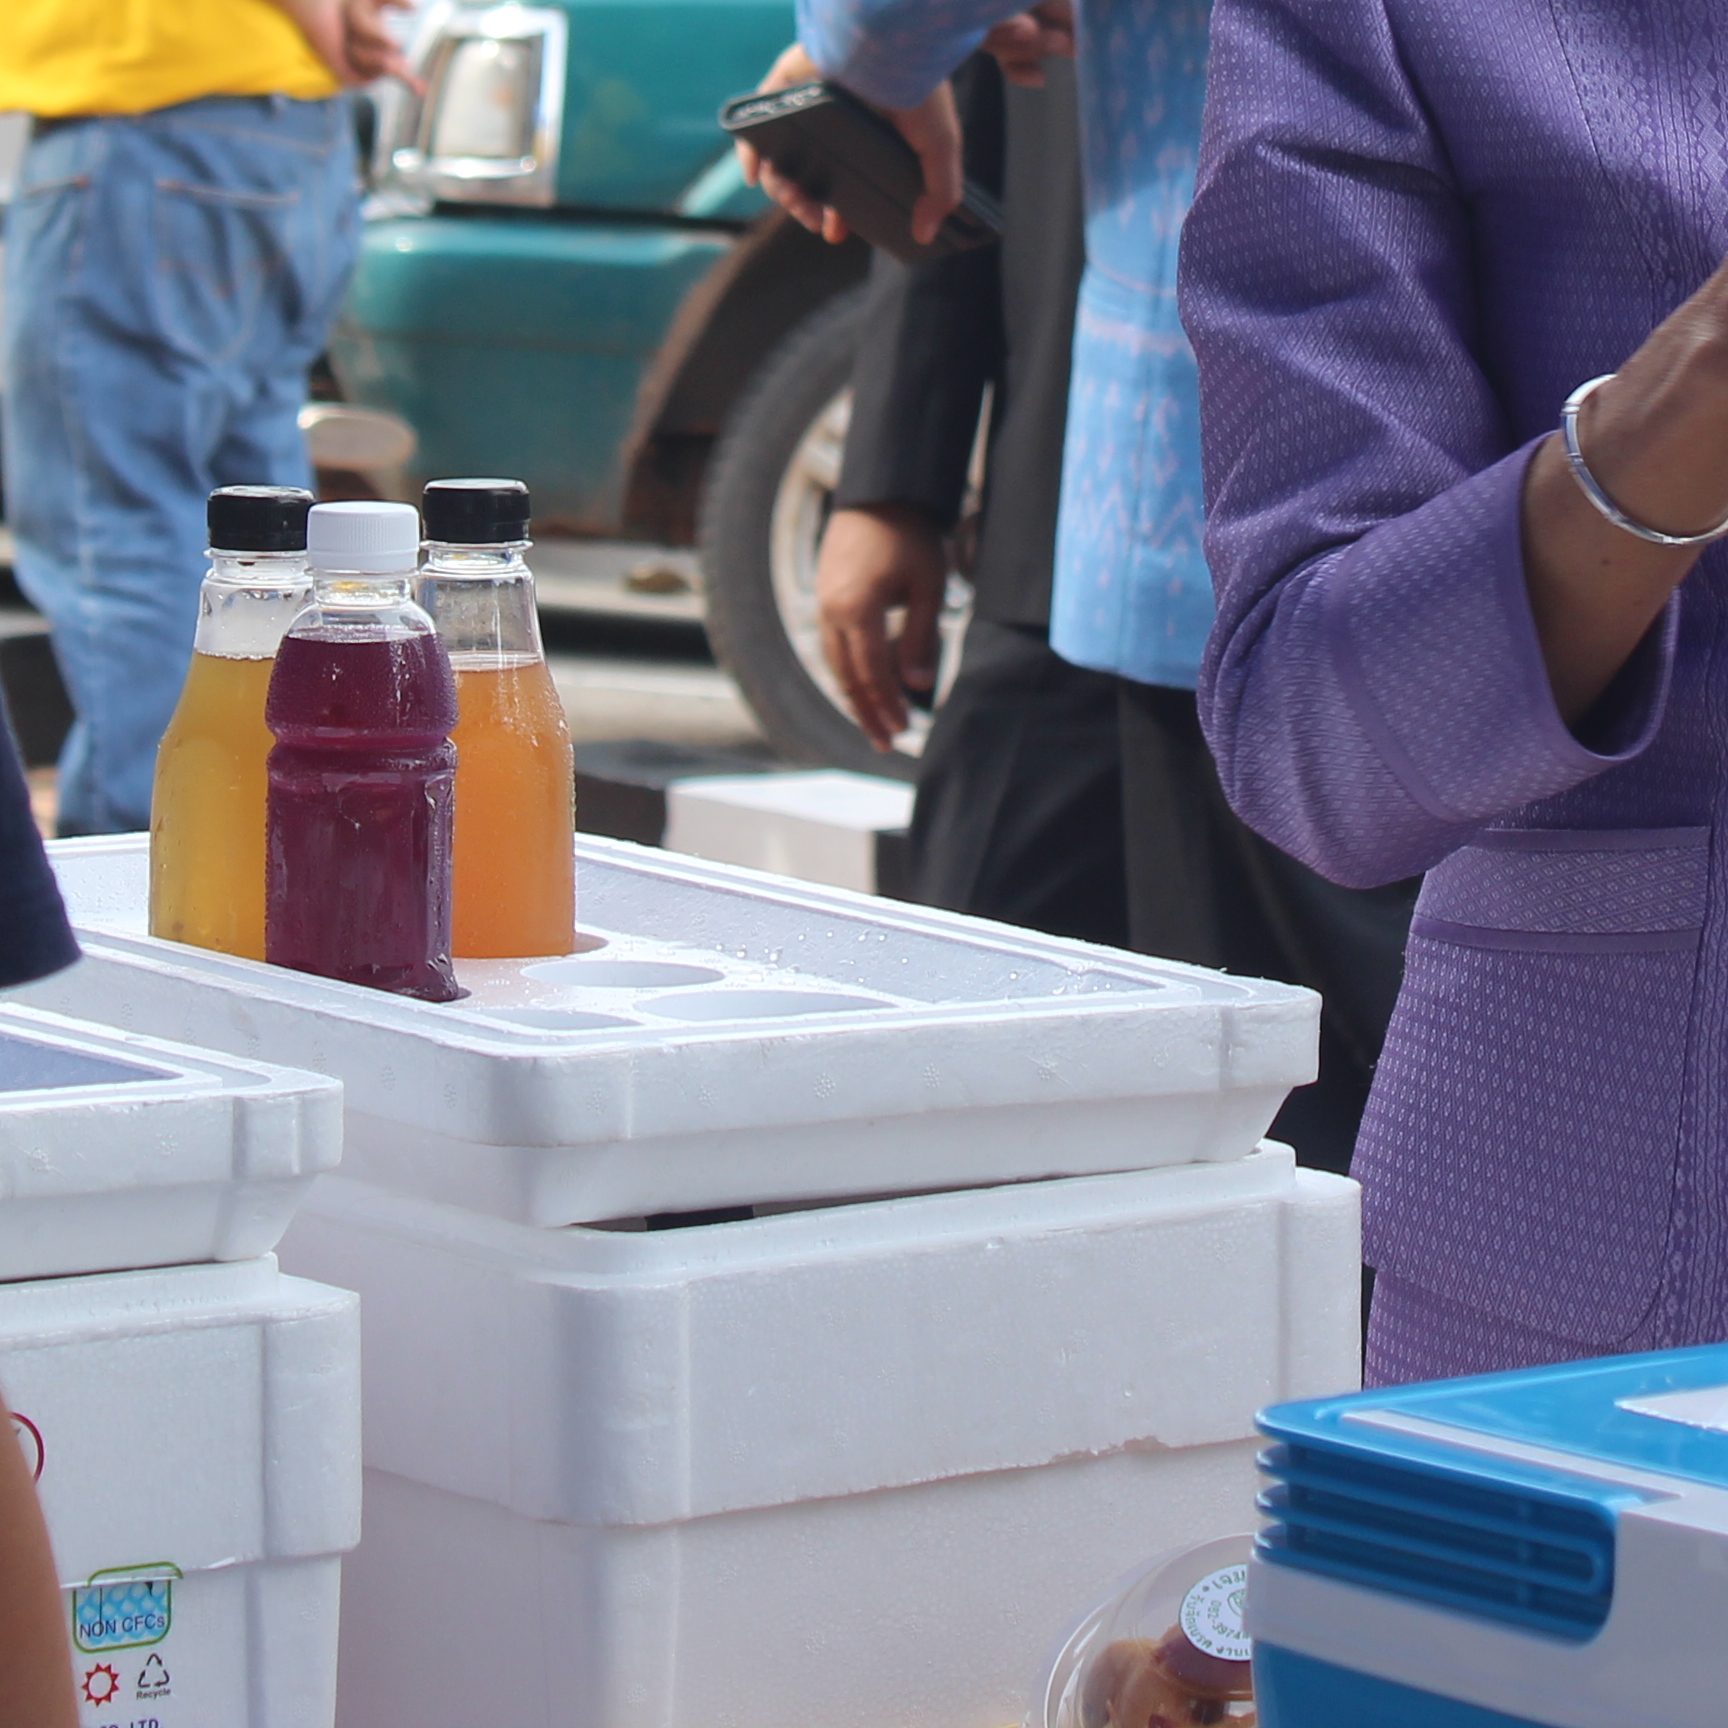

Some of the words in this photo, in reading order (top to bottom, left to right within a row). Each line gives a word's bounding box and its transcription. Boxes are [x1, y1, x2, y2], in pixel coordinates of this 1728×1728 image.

[79, 1619, 117, 1639] NON
[121, 1613, 165, 1633] CFCs
[136, 1687, 171, 1701] Recycle
